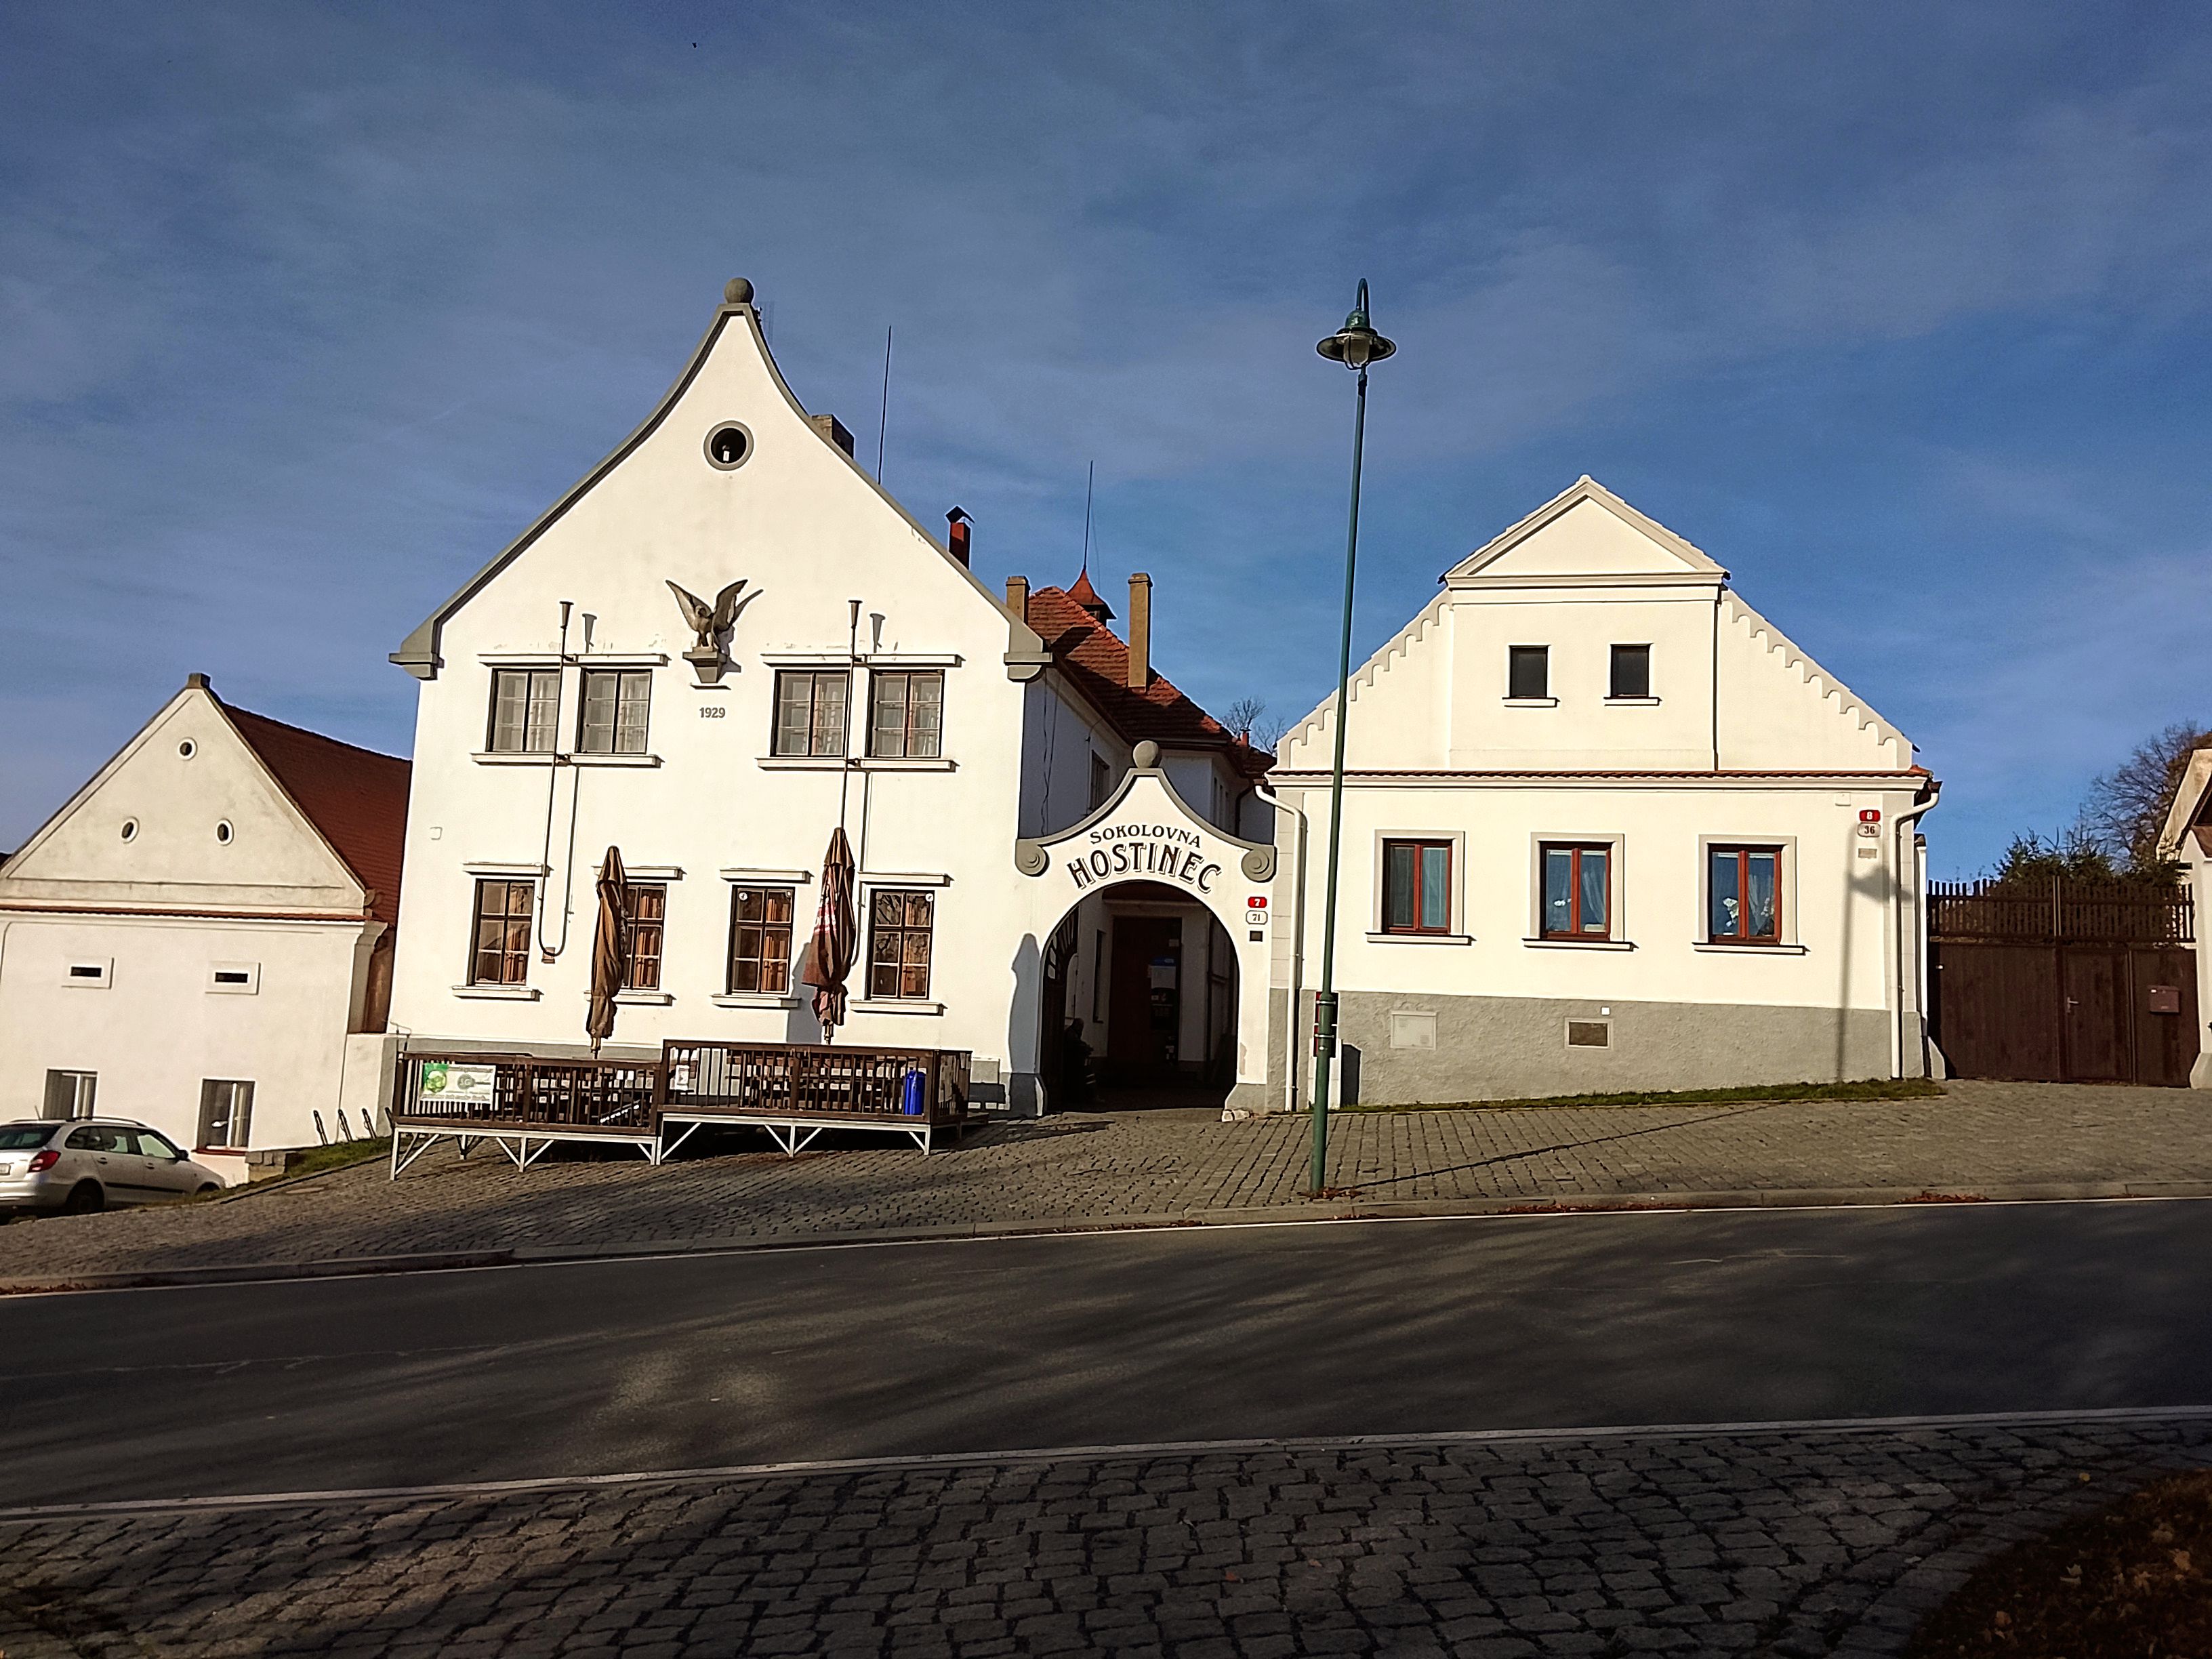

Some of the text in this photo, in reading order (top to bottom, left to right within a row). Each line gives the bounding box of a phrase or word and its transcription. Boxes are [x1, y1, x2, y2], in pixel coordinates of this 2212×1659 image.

[699, 707, 726, 718] 1929
[1866, 811, 1873, 820] 8
[1864, 825, 1876, 834] 36
[1090, 824, 1201, 848] SOKOLOVNA
[1066, 842, 1223, 895] HOSTINEC
[1254, 898, 1261, 907] 7
[1252, 914, 1261, 922] 71
